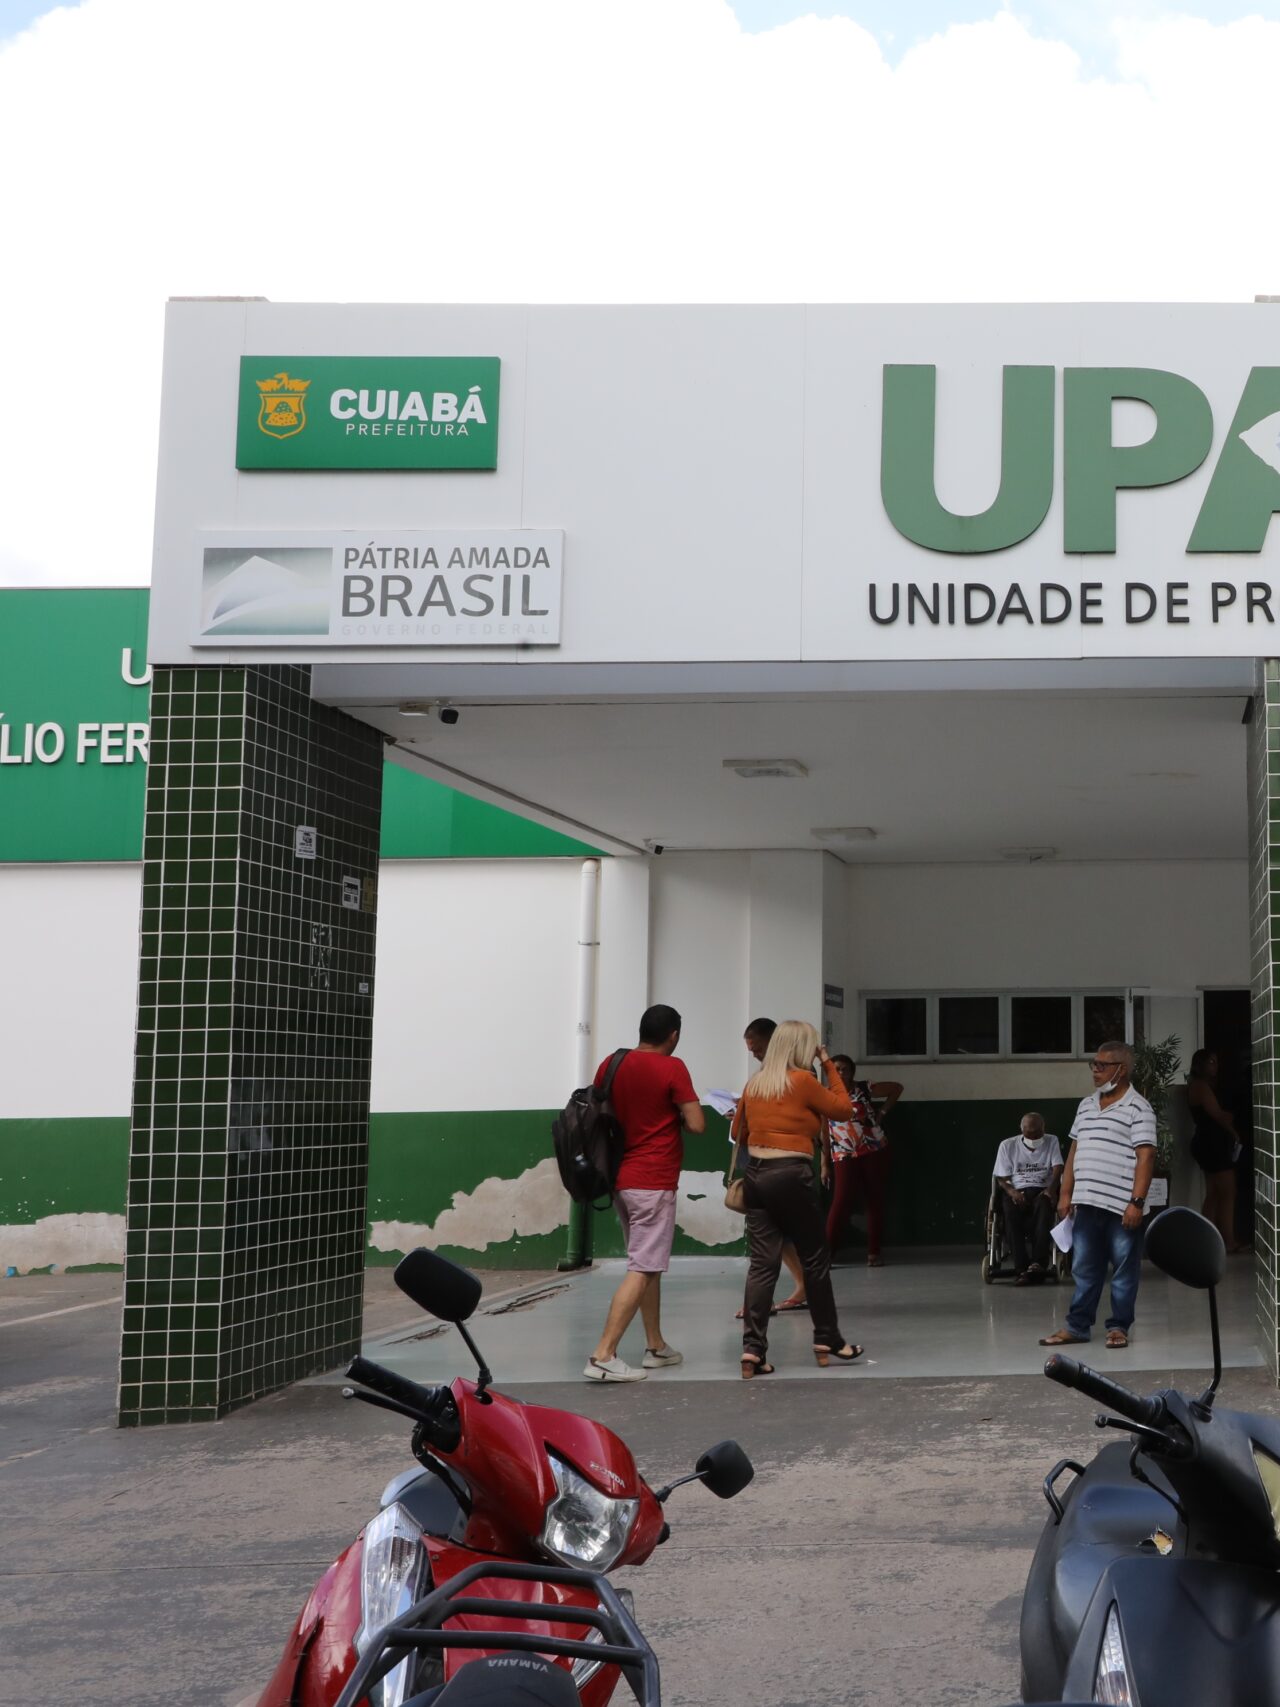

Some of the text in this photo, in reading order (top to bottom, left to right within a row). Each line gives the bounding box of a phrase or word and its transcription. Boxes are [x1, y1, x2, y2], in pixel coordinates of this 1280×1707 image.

[330, 385, 487, 424] CUIABÁ
[346, 423, 469, 436] PREFEITURA
[344, 541, 551, 570] PÁTRIA AMADA
[341, 574, 549, 618] BRASIL
[868, 581, 1104, 626] UNIDADE
[1125, 581, 1190, 625] DE
[341, 622, 549, 636] GOVERNO FEDERAL
[0, 712, 65, 764] LIO
[488, 1659, 549, 1673] YAMAHA
